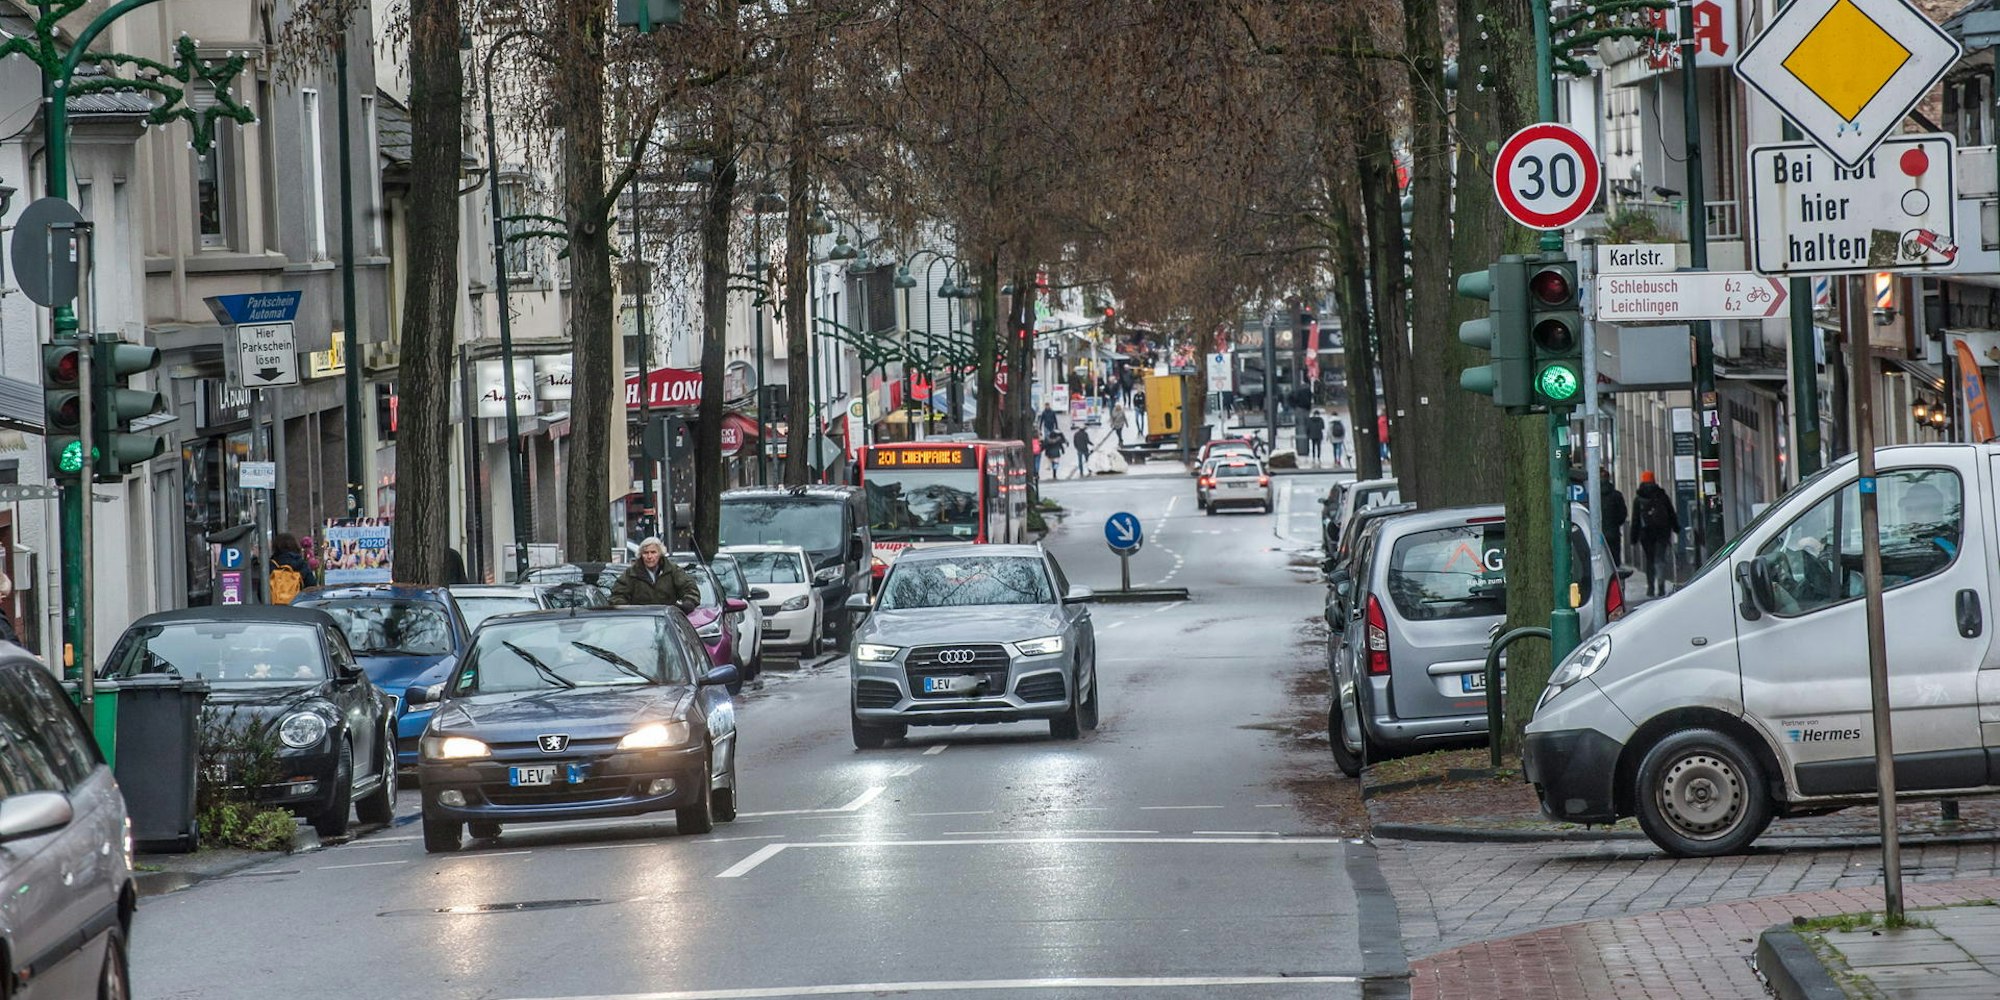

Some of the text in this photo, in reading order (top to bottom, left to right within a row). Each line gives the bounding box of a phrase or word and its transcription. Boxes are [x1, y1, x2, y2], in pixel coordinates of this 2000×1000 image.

[1773, 153, 1812, 184] Bei
[1518, 153, 1577, 200] 30
[1801, 193, 1849, 222] hier
[1789, 233, 1866, 262] halten
[1610, 249, 1663, 266] Karlstr.
[1610, 279, 1678, 294] Schlebusch
[247, 295, 294, 308] Parkschein
[1611, 298, 1679, 316] Leichlingen
[249, 308, 286, 320] Automat
[256, 328, 275, 338] Hier
[242, 341, 292, 352] Parkschein
[255, 354, 280, 365] lösen
[878, 451, 896, 465] 201
[1556, 450, 1562, 458] 5
[1574, 485, 1584, 500] P
[360, 539, 385, 547] 2020
[227, 548, 240, 567] P
[932, 679, 950, 690] LEV
[1803, 728, 1860, 742] Hermes
[519, 769, 544, 783] LEV
